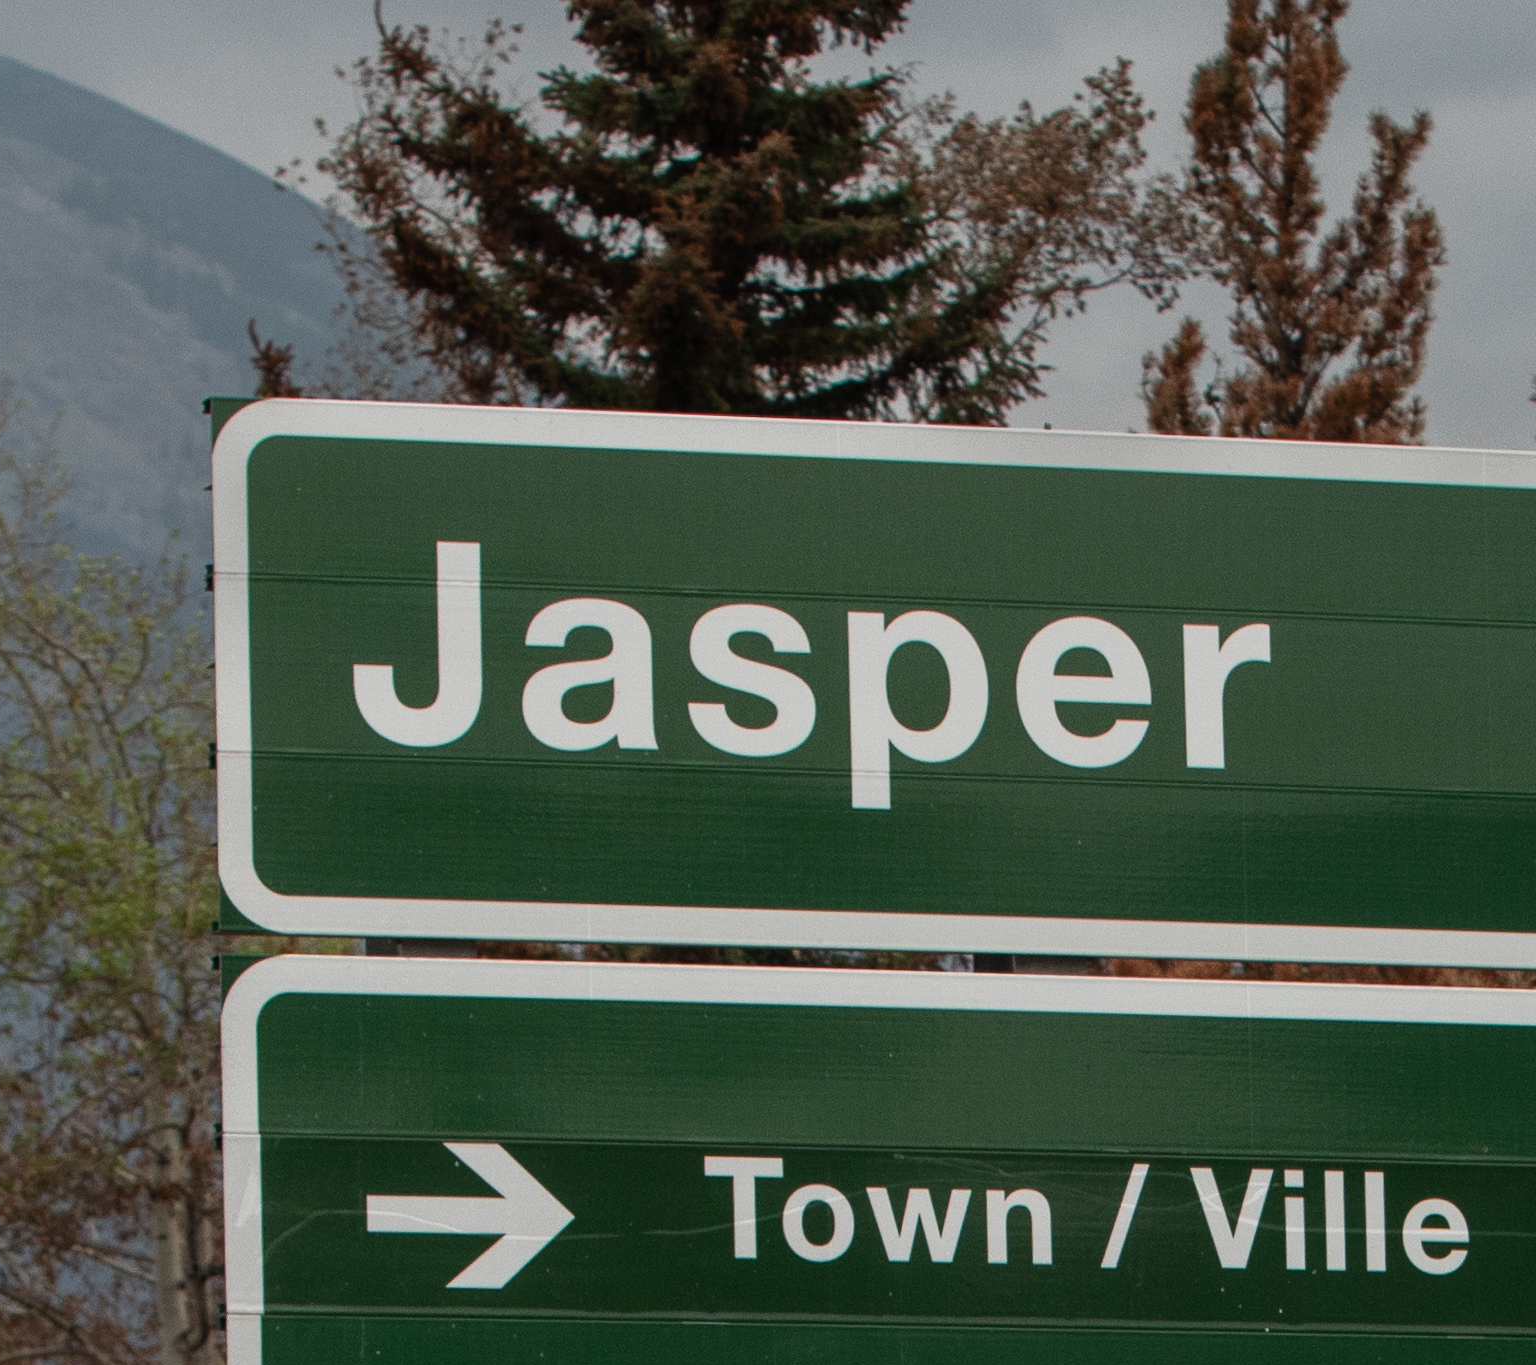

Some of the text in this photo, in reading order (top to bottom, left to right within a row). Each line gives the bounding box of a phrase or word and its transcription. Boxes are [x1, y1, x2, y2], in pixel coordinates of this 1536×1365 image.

[351, 540, 1273, 810] Jasper
[703, 1155, 1470, 1275] Town / Ville
